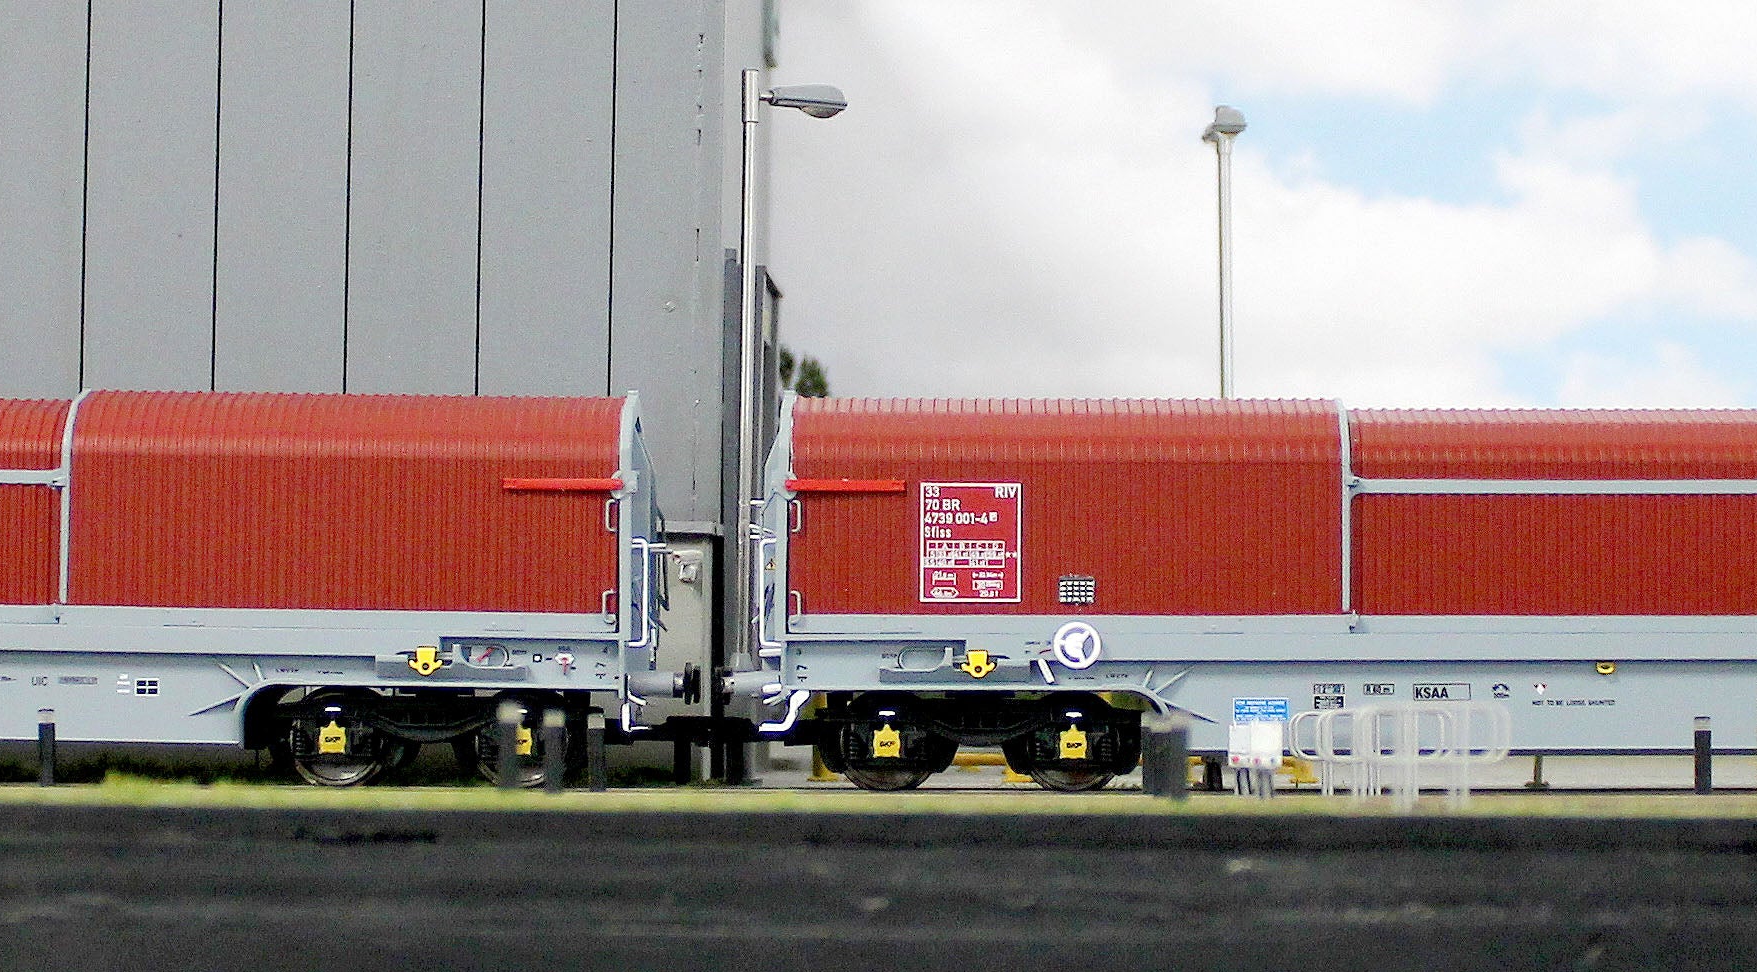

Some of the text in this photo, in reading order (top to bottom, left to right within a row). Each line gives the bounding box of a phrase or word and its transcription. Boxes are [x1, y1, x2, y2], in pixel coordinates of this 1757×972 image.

[925, 485, 940, 497] 33
[994, 486, 1017, 498] RIV
[925, 499, 961, 511] 70 BR
[924, 512, 953, 524] 4739
[955, 512, 988, 525] 001-4
[1415, 687, 1449, 699] KSAA
